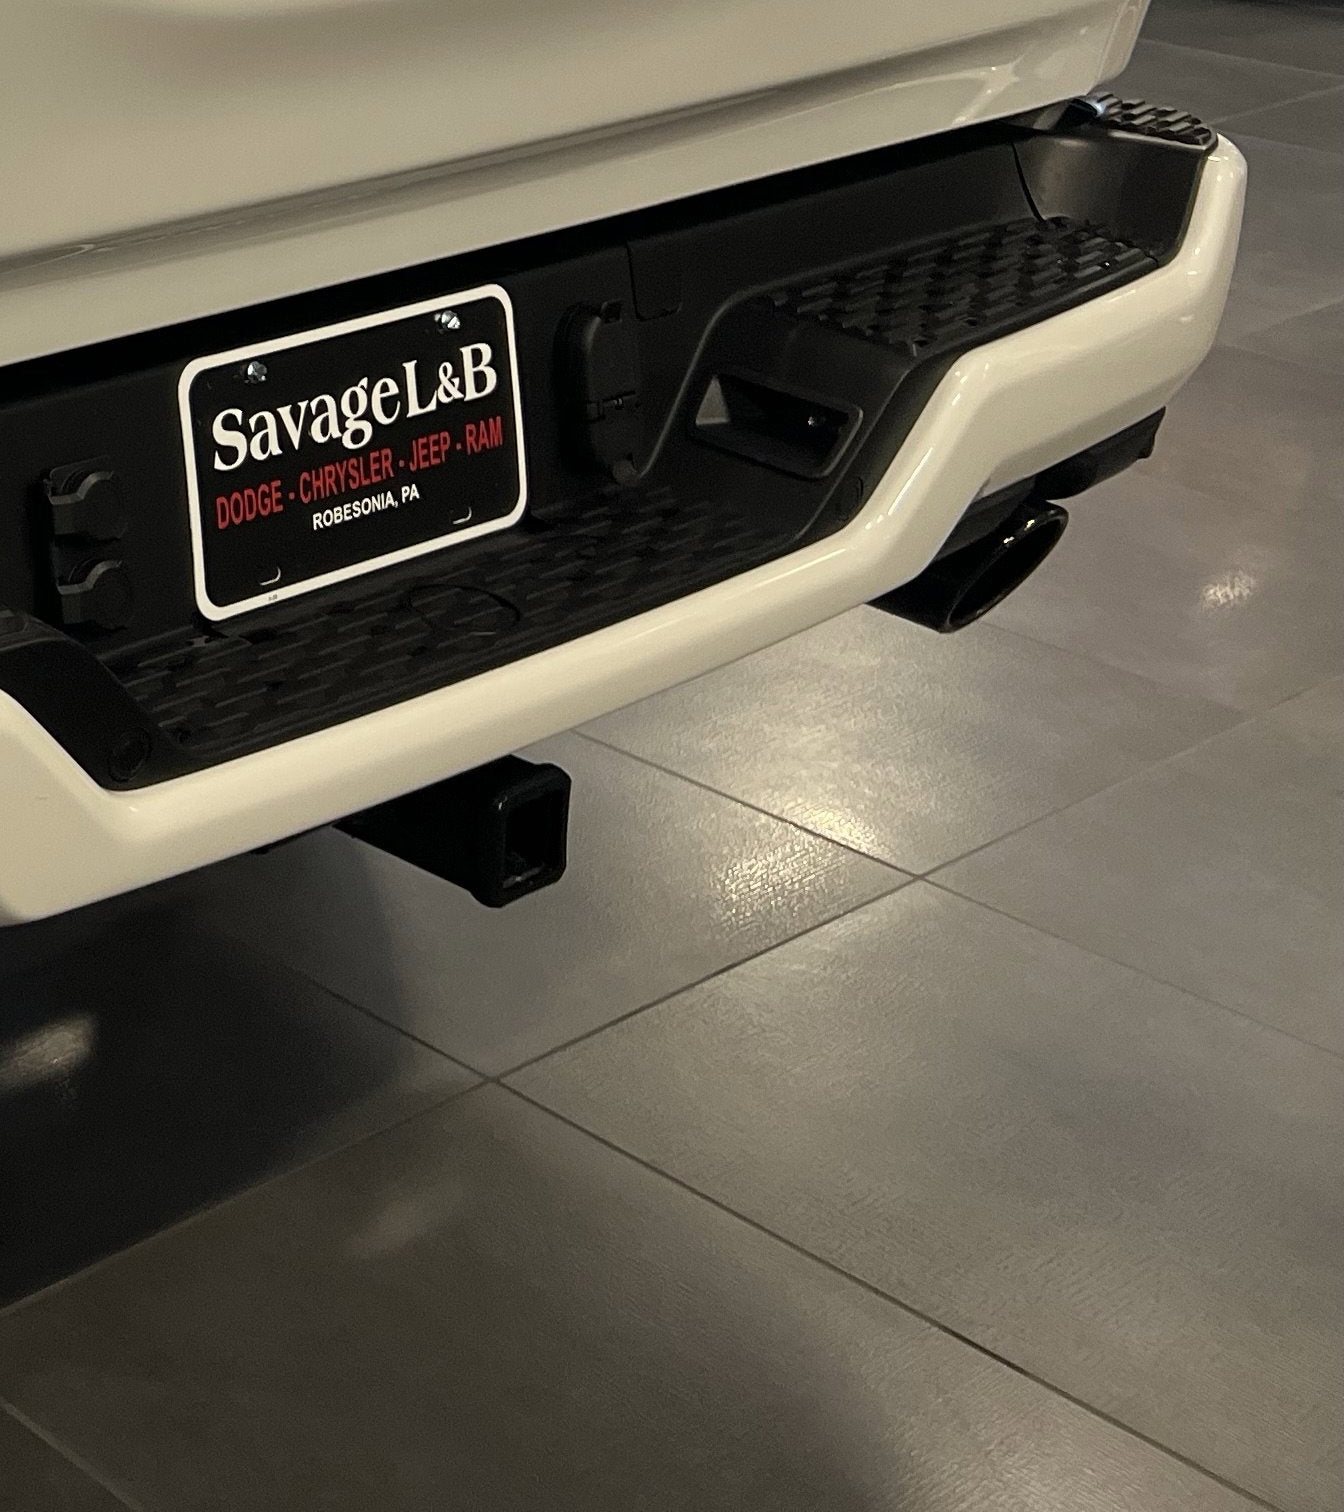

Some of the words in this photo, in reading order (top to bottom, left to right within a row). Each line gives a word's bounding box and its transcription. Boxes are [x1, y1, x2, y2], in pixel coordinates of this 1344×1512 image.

[215, 479, 283, 530] DODGE
[298, 447, 395, 505] CHRYSLER
[409, 431, 451, 472] JEEP
[465, 415, 504, 456] RAM
[312, 489, 399, 531] ROBESONIA,
[401, 482, 420, 501] PA
